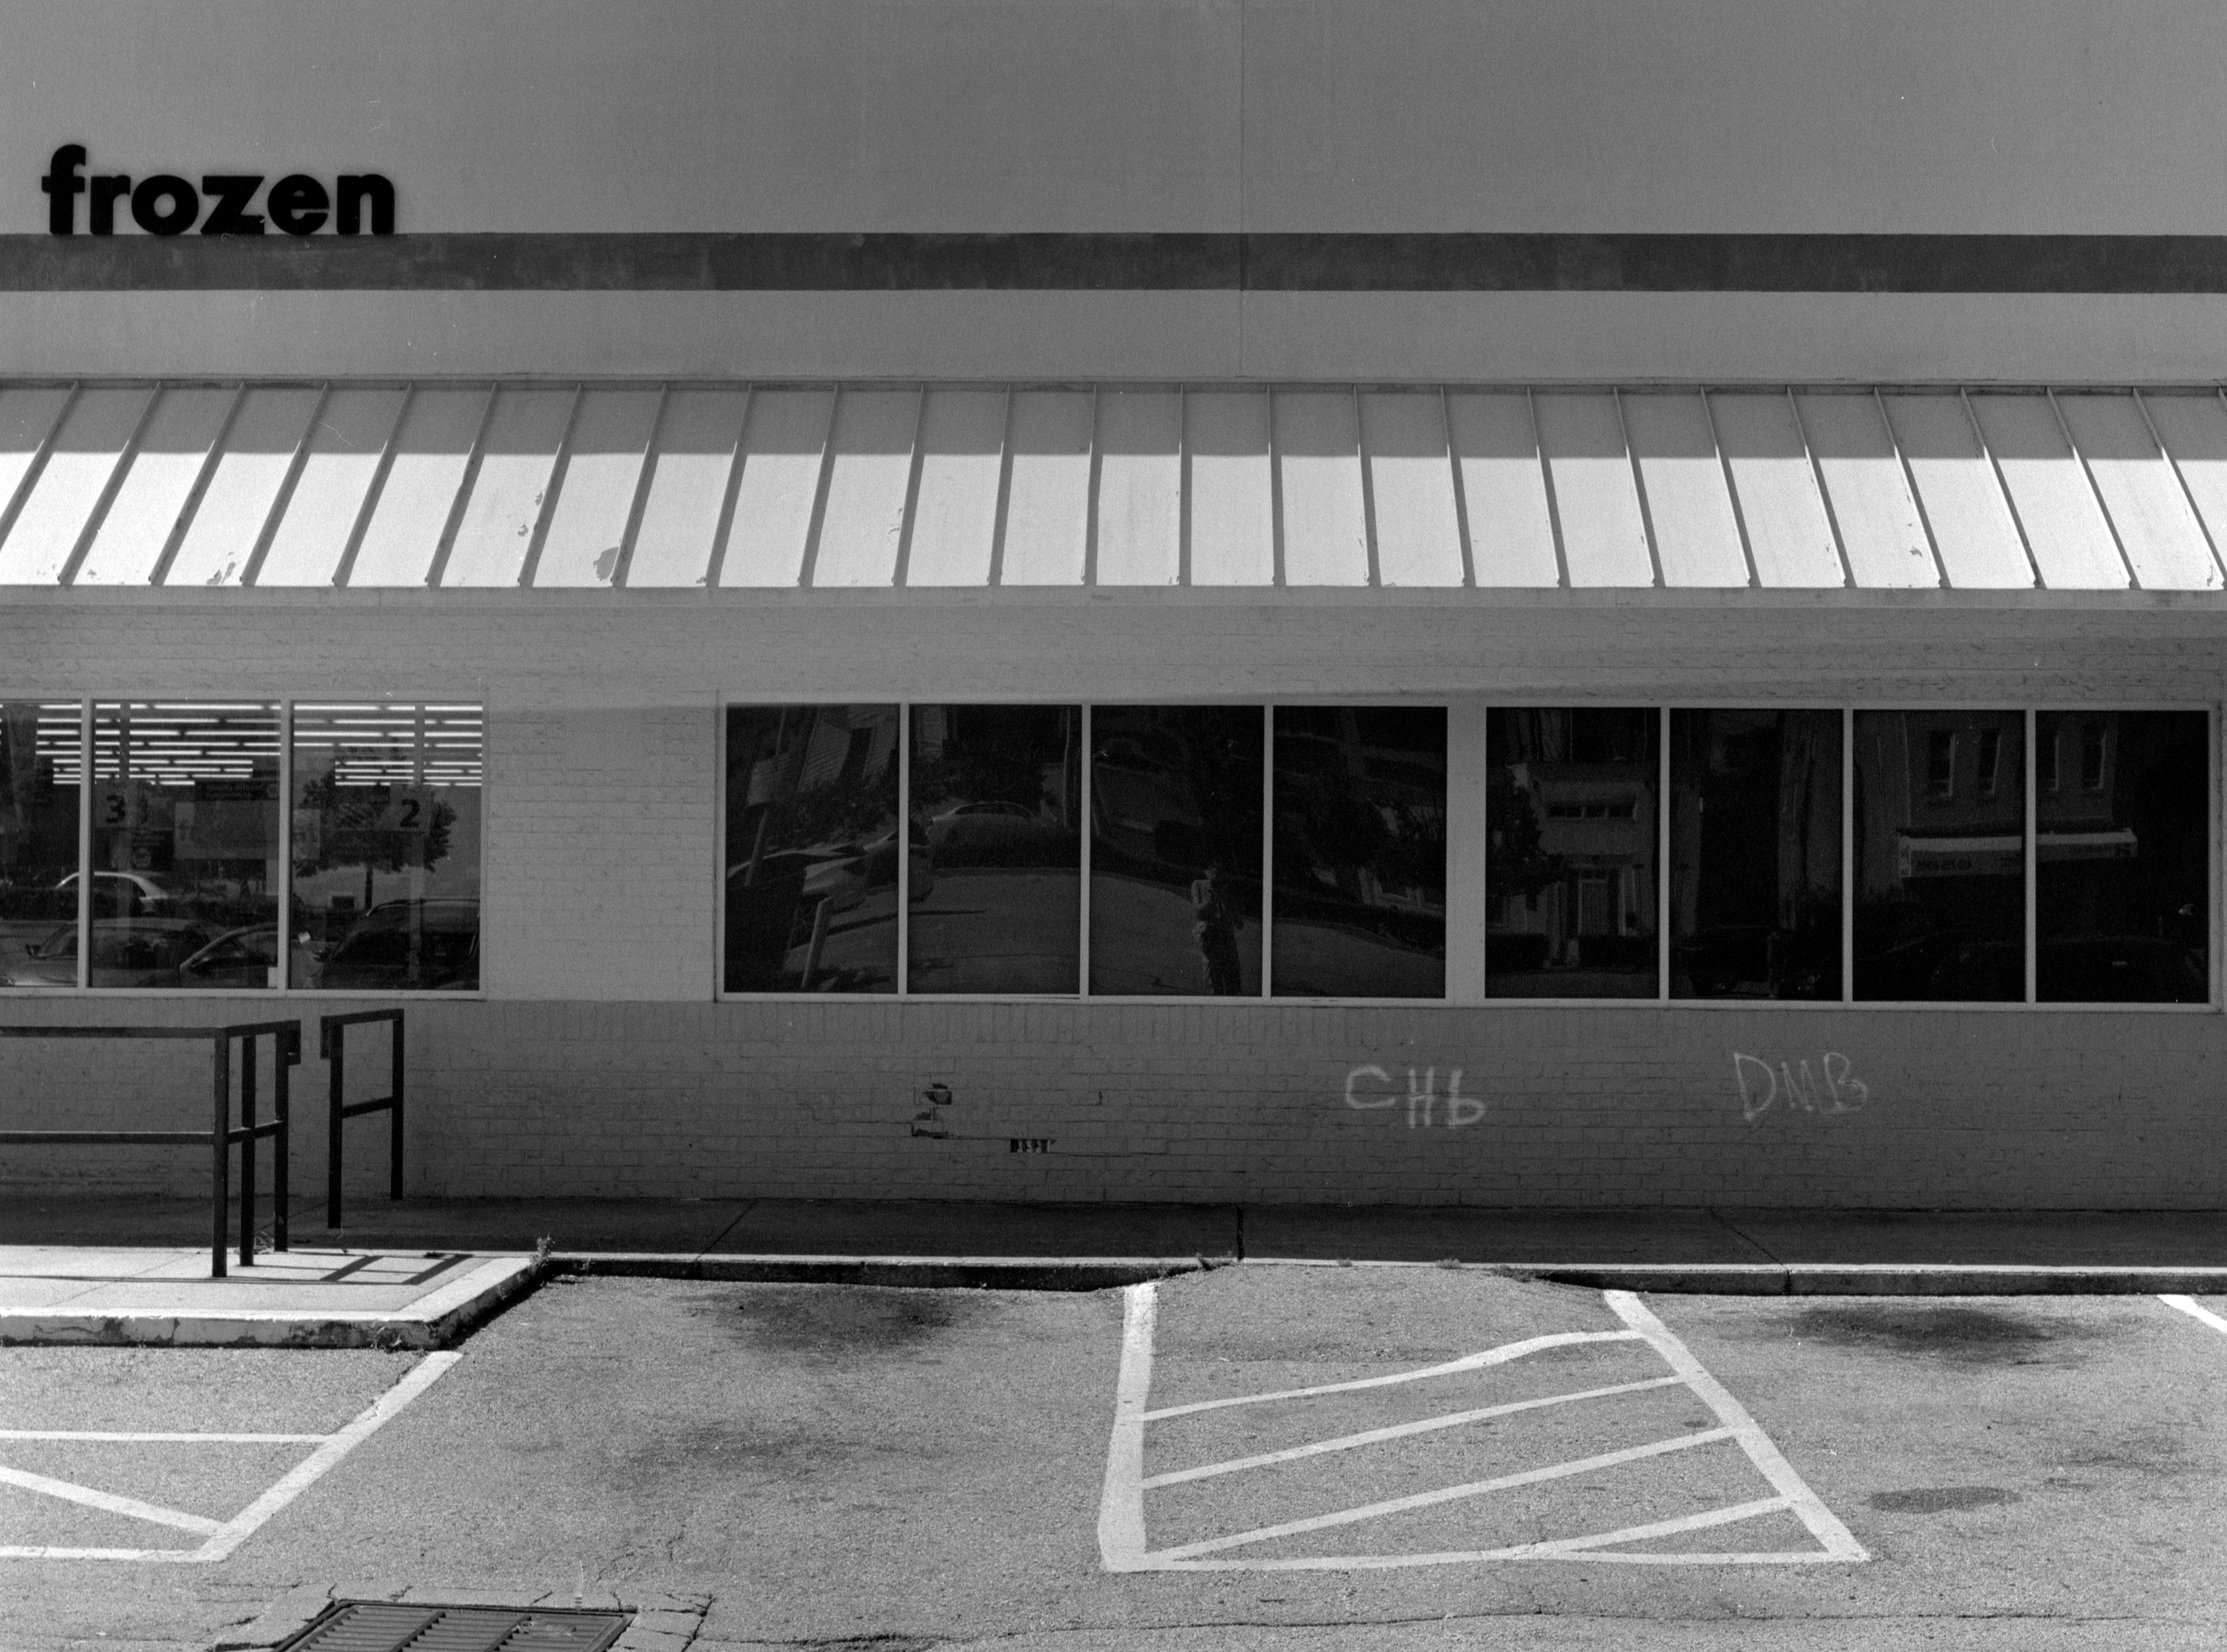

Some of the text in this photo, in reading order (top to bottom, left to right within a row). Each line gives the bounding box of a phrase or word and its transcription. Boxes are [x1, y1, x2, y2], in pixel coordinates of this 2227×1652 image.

[42, 144, 395, 235] frozen
[106, 795, 126, 823] 3
[400, 798, 420, 827] 2
